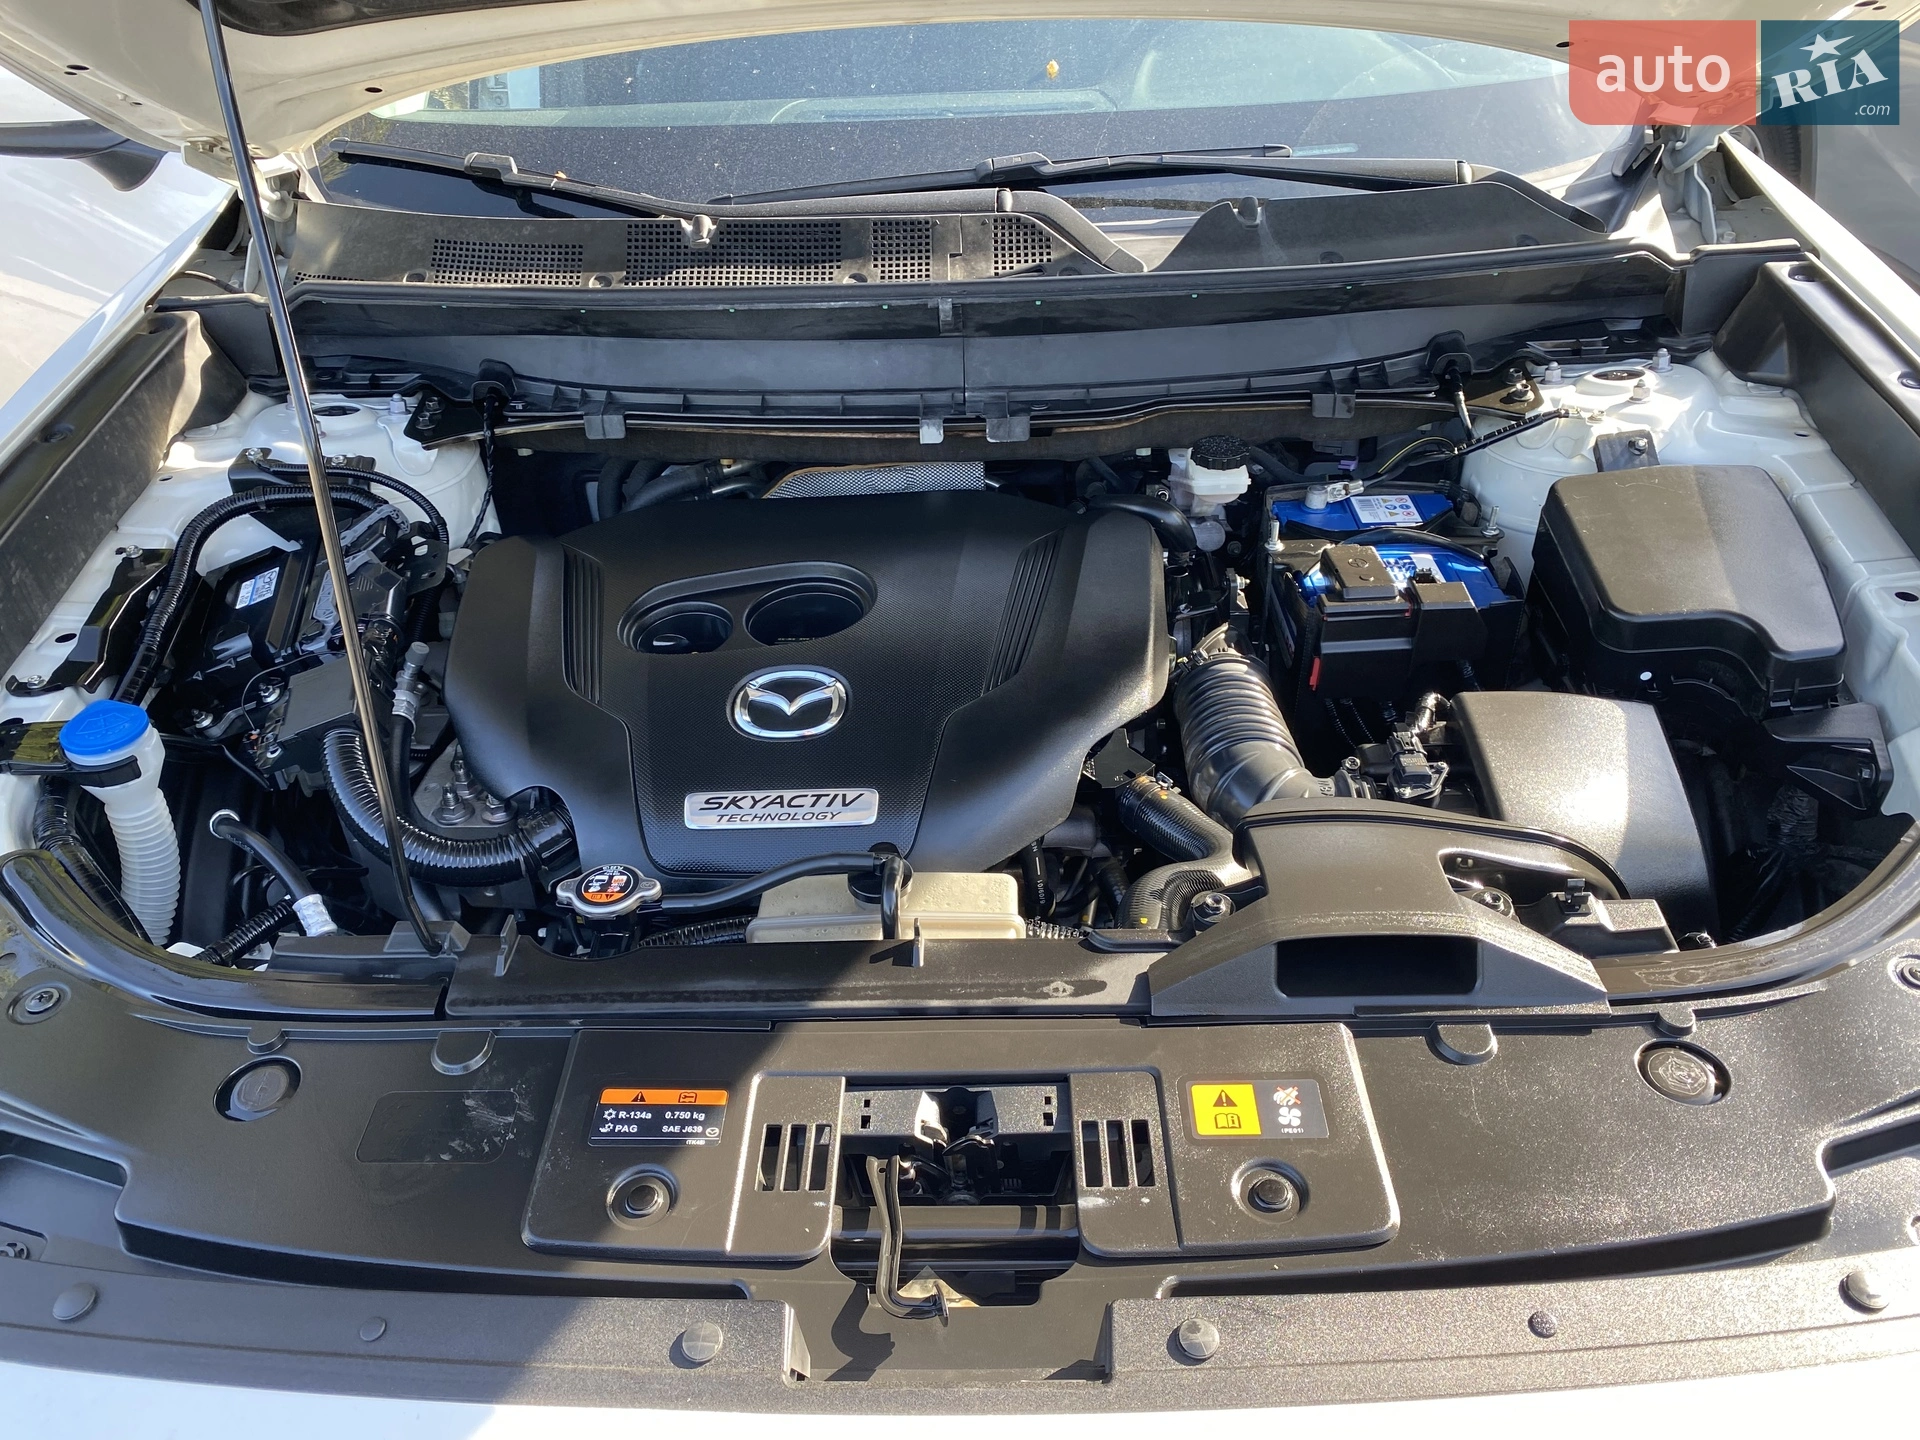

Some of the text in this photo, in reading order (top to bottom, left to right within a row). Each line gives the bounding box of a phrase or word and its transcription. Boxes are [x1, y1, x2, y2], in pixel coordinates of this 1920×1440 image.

[698, 793, 865, 811] SKYACTIV
[716, 811, 842, 823] TECHNOLOGY
[618, 1111, 706, 1121] R-134a 0.750 kg
[614, 1125, 703, 1133] PAG SAE J639
